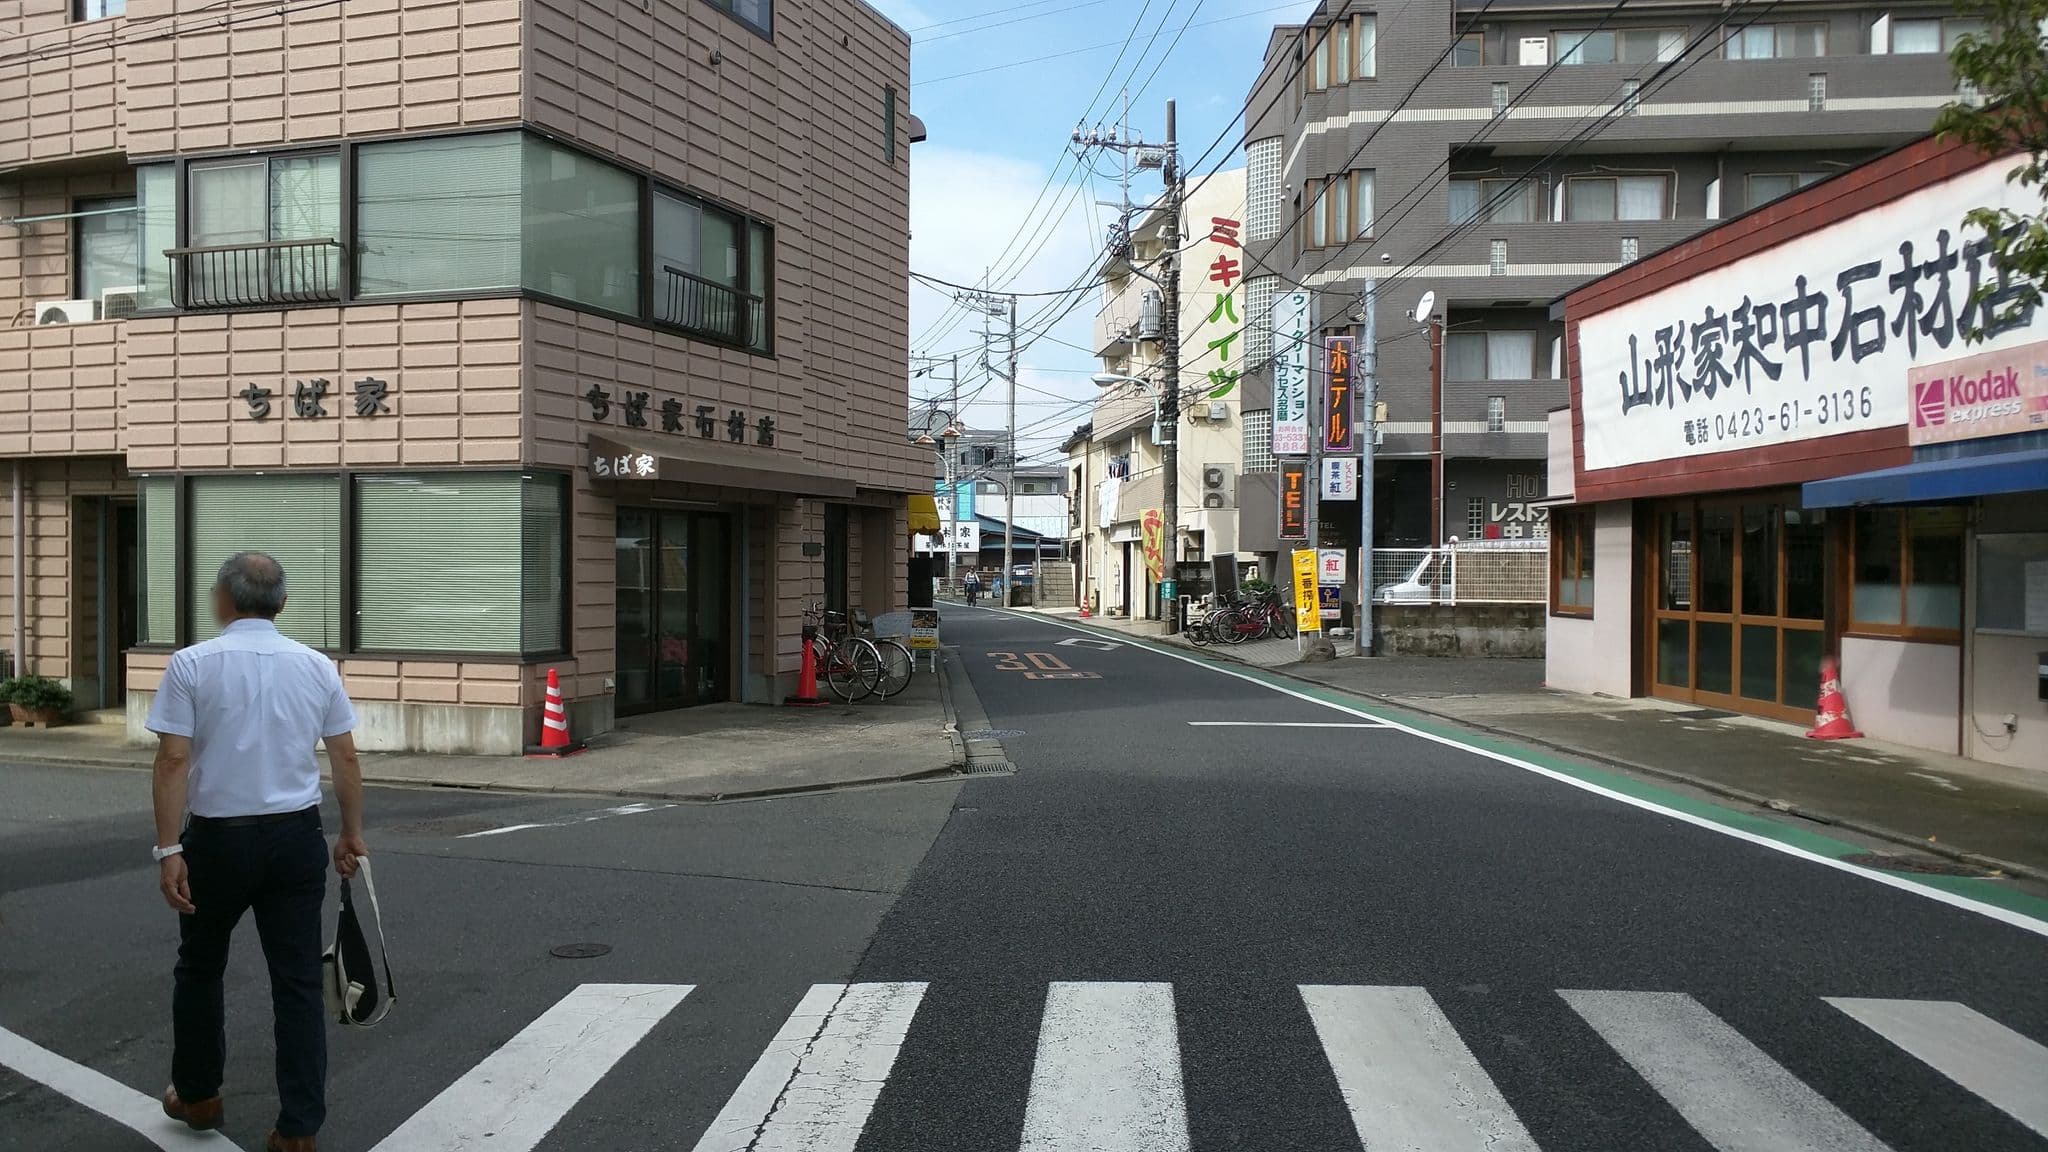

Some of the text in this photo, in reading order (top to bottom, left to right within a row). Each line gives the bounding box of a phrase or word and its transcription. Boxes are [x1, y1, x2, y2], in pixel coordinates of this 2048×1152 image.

[1208, 216, 1241, 399] ミキハイツ
[1619, 220, 2043, 416] 山形家和中石材店
[1292, 293, 1305, 422] ウィークリーマンション
[239, 376, 391, 419] ちば家
[1328, 341, 1348, 443] ホテル
[1949, 365, 2021, 407] Kodak
[1951, 400, 2022, 425] express
[586, 383, 777, 447] ちば家石材店
[1683, 386, 1872, 447] 電話 0423-61-3136
[593, 454, 656, 477] ちば家
[1285, 472, 1303, 527] TEL
[1326, 559, 1339, 571] 紅
[986, 652, 1072, 670] 30
